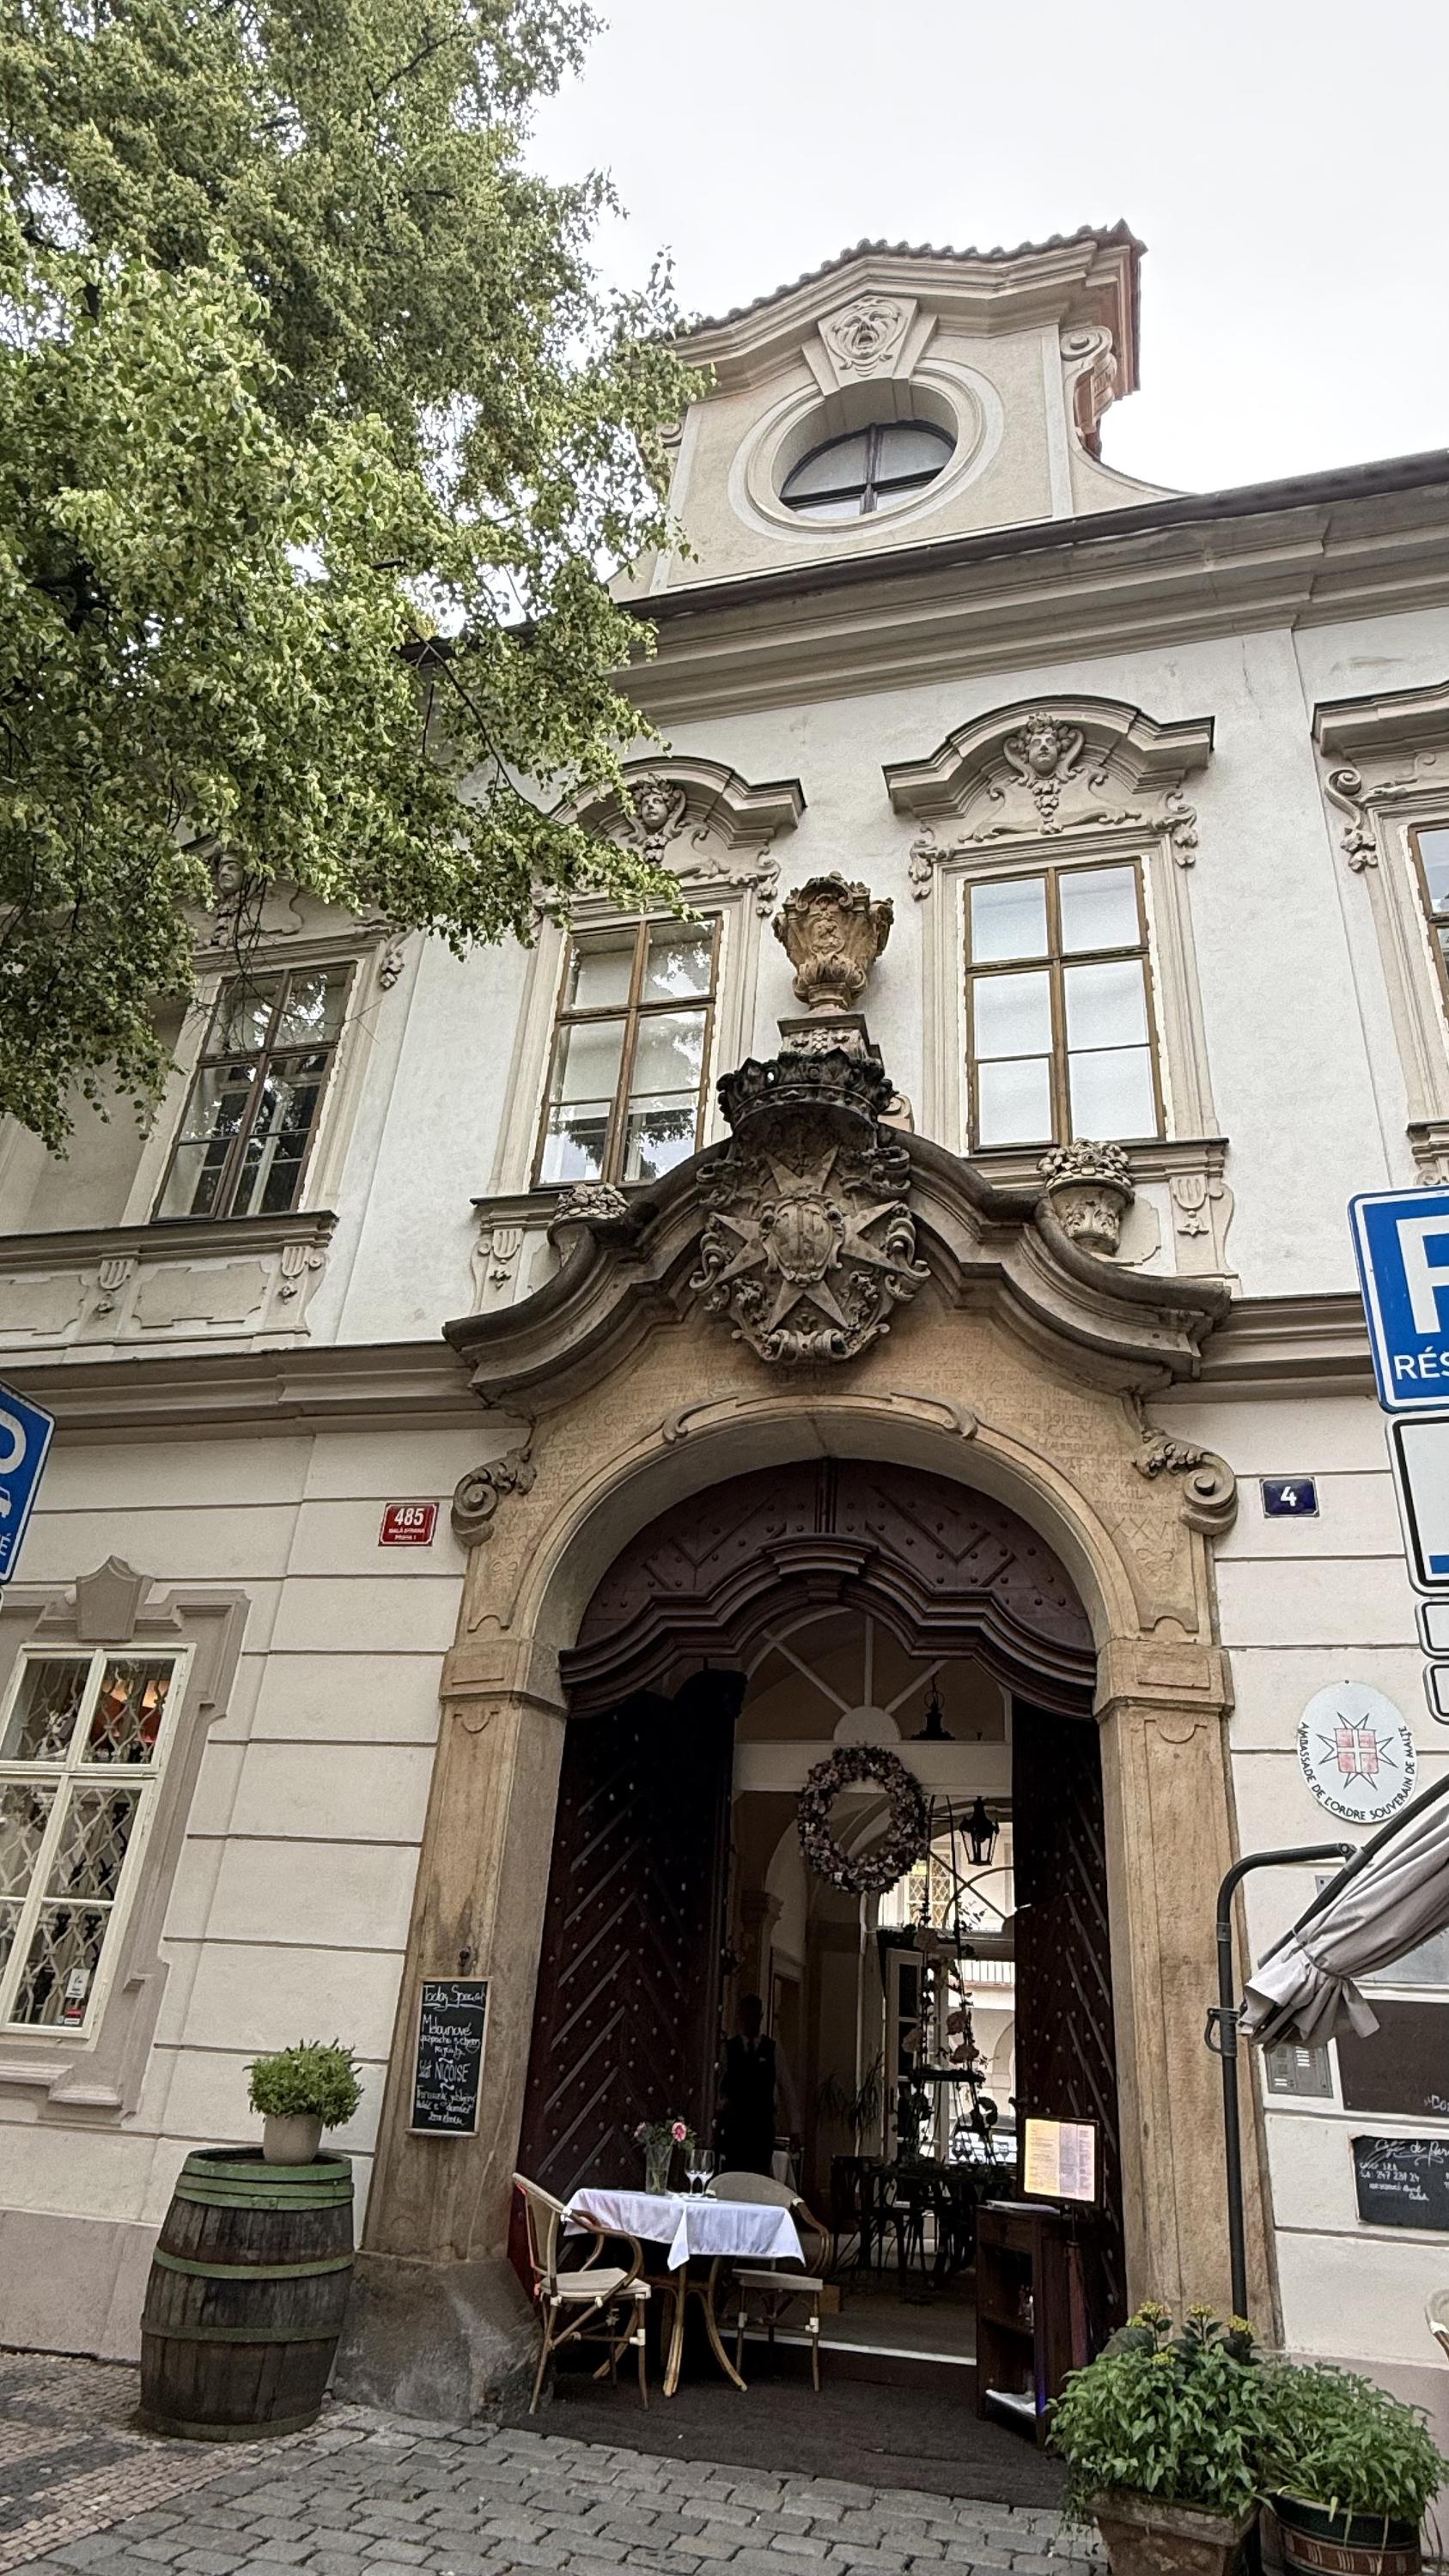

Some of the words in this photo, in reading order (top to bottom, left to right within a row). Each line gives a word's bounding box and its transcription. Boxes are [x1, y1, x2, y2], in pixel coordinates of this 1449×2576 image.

[1281, 1486, 1297, 1507] 4
[394, 1508, 425, 1526] 485
[1298, 1722, 1316, 1783] AMBASSADE
[1398, 1725, 1415, 1759] MALTE
[1405, 1761, 1415, 1775] DE
[1312, 1784, 1326, 1799] DE
[1370, 1777, 1412, 1820] SOUVERAIN
[423, 1985, 448, 2012] Today
[452, 1984, 485, 2008] Special
